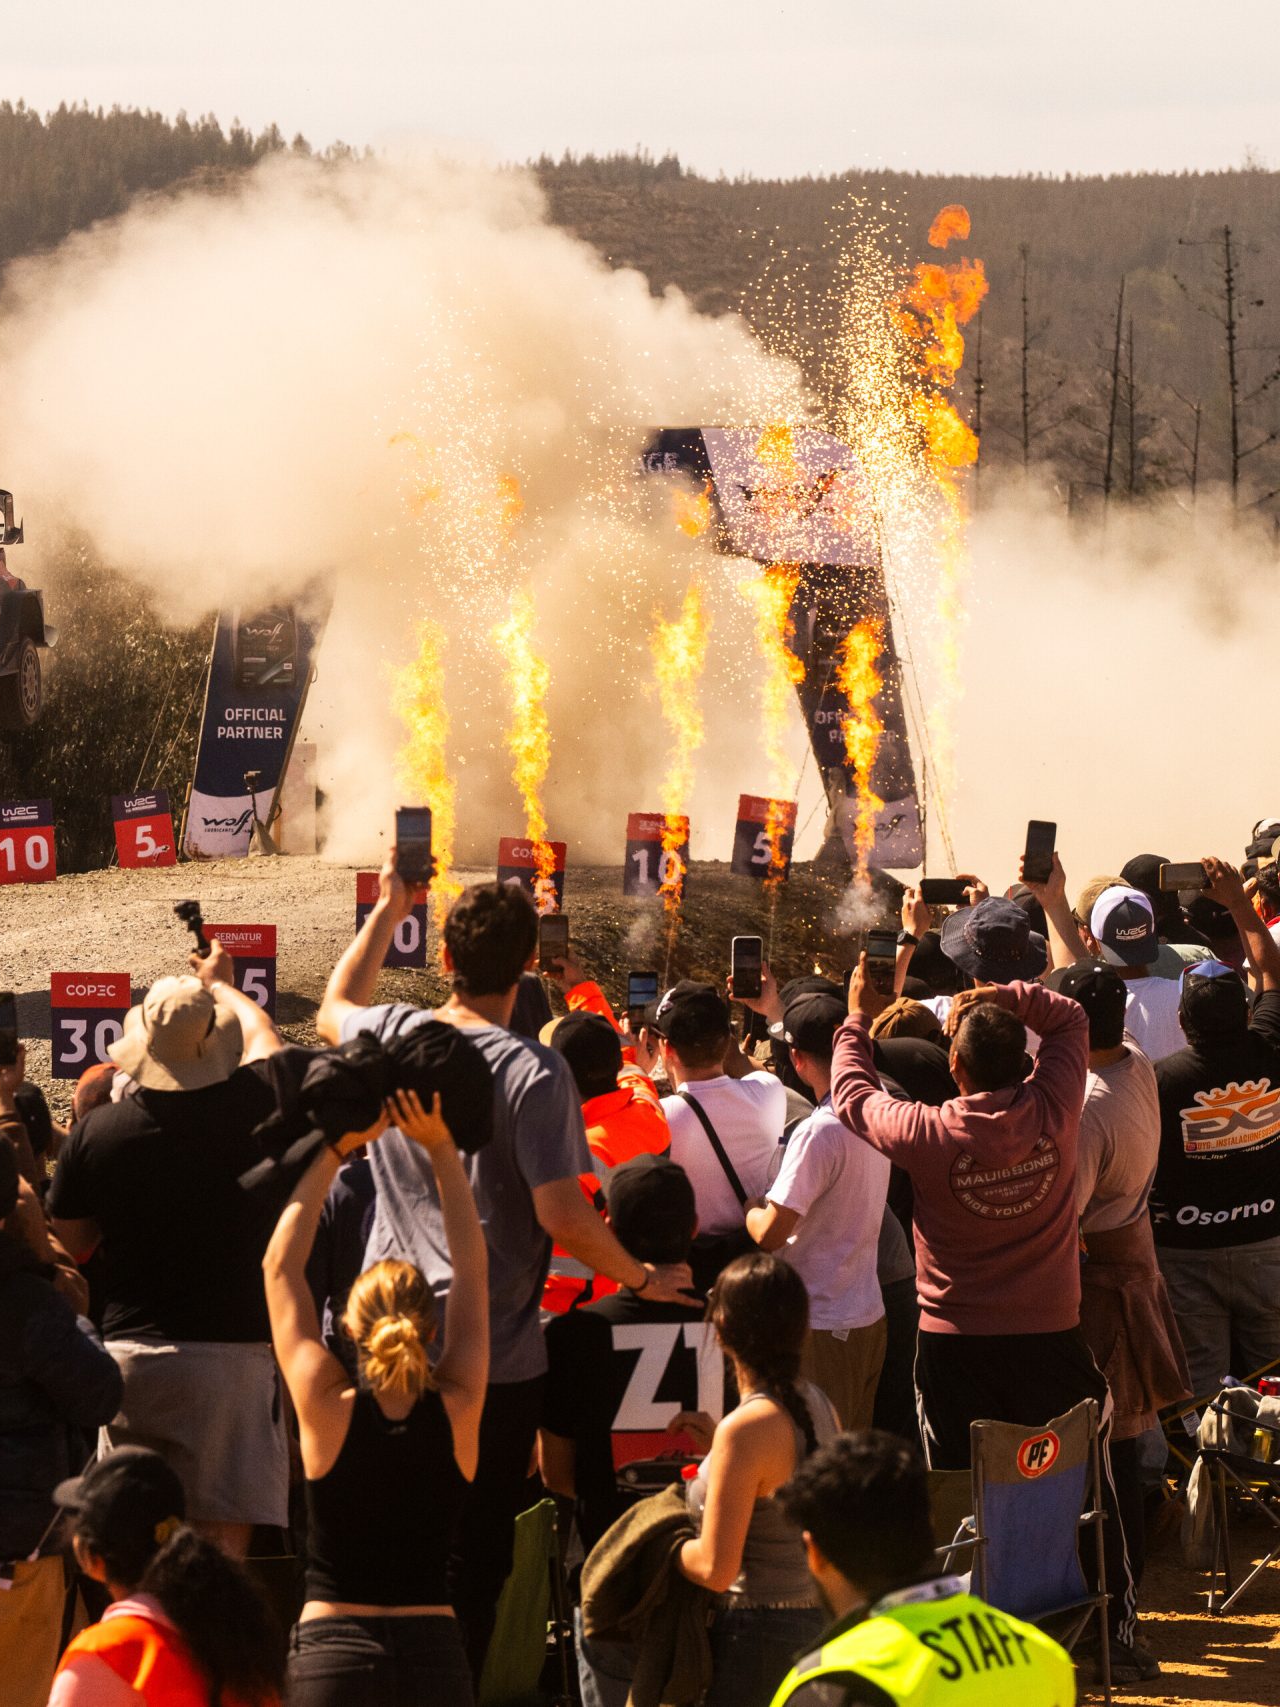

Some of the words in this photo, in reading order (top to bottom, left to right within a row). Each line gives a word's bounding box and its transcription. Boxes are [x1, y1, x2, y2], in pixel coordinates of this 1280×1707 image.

[225, 708, 286, 721] OFFICIAL
[217, 726, 283, 739] PARTNER
[2, 806, 38, 816] WRC
[124, 795, 156, 808] WRC
[136, 825, 157, 858] 5
[751, 831, 773, 864] 5
[631, 848, 683, 885] 10
[214, 932, 262, 940] SERNATUR
[1116, 924, 1146, 936] WRC
[66, 985, 116, 996] COPEC
[60, 1019, 124, 1063] 30
[1034, 1173, 1054, 1201] LIFE
[962, 1193, 989, 1214] RIDE
[995, 1201, 1032, 1216] YOUR
[1176, 1198, 1275, 1226] Osorno
[918, 1611, 1031, 1681] STAFF
